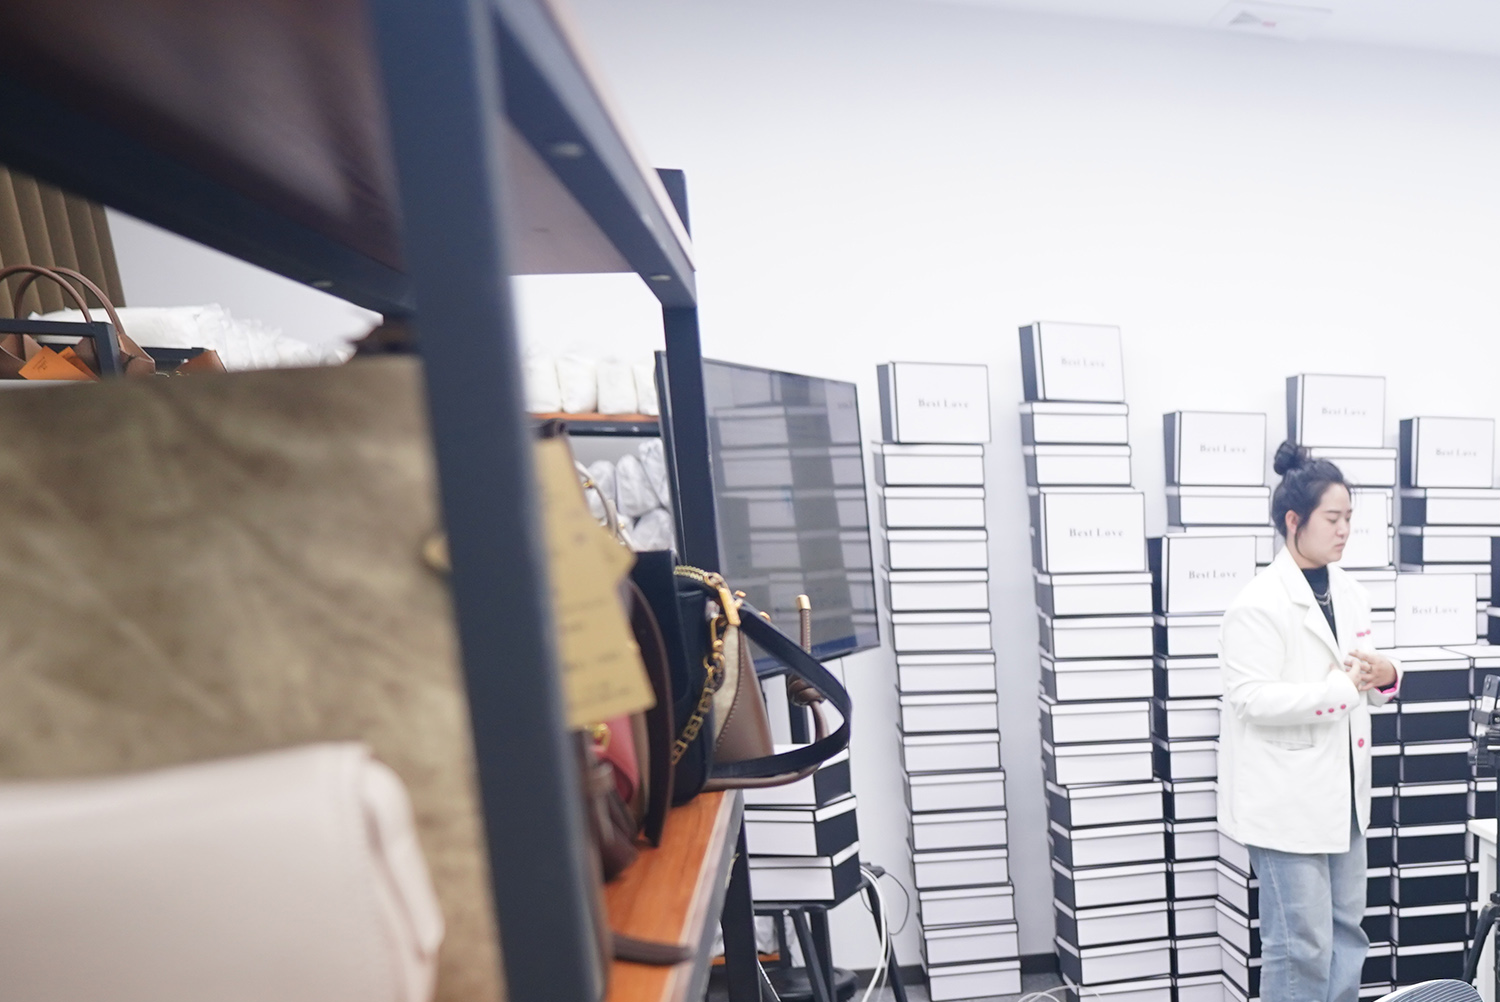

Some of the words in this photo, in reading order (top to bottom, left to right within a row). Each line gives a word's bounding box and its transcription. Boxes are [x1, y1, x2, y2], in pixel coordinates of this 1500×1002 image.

[1069, 527, 1092, 538] Best
[1096, 527, 1124, 538] Love
[1188, 569, 1209, 580] Best
[1212, 569, 1238, 579] Love
[1411, 605, 1432, 615] Best
[1434, 605, 1458, 615] Love
